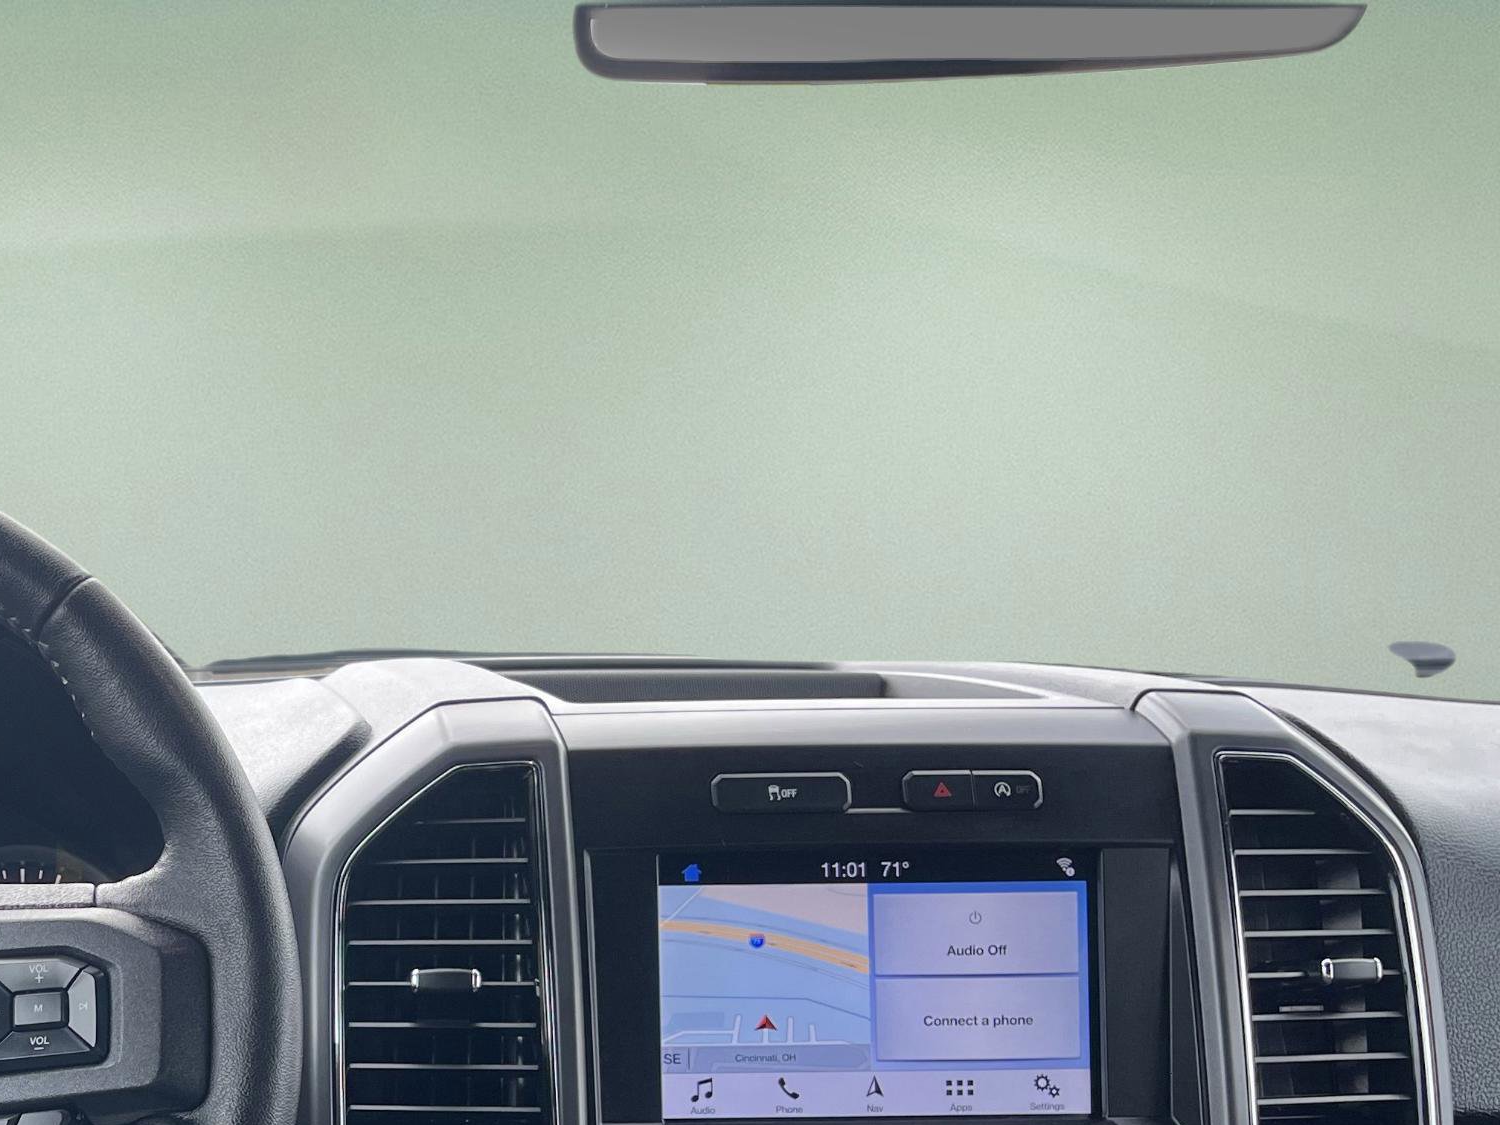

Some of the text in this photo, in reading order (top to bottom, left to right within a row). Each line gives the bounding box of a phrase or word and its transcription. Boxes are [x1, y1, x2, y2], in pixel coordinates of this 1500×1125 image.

[781, 788, 797, 798] OFF
[821, 861, 910, 878] 11:01 71°
[947, 945, 1007, 956] Audio Off
[29, 964, 49, 973] VOL
[34, 1004, 43, 1012] M
[923, 1014, 1034, 1032] Connect a phone
[29, 1036, 50, 1045] VOL
[663, 1054, 681, 1065] SE
[781, 1053, 796, 1062] OH
[690, 1106, 716, 1115] Audio
[775, 1105, 803, 1114] Phone
[867, 1104, 884, 1113] Nav
[950, 1103, 973, 1115] Apps
[1030, 1102, 1065, 1113] Settings
